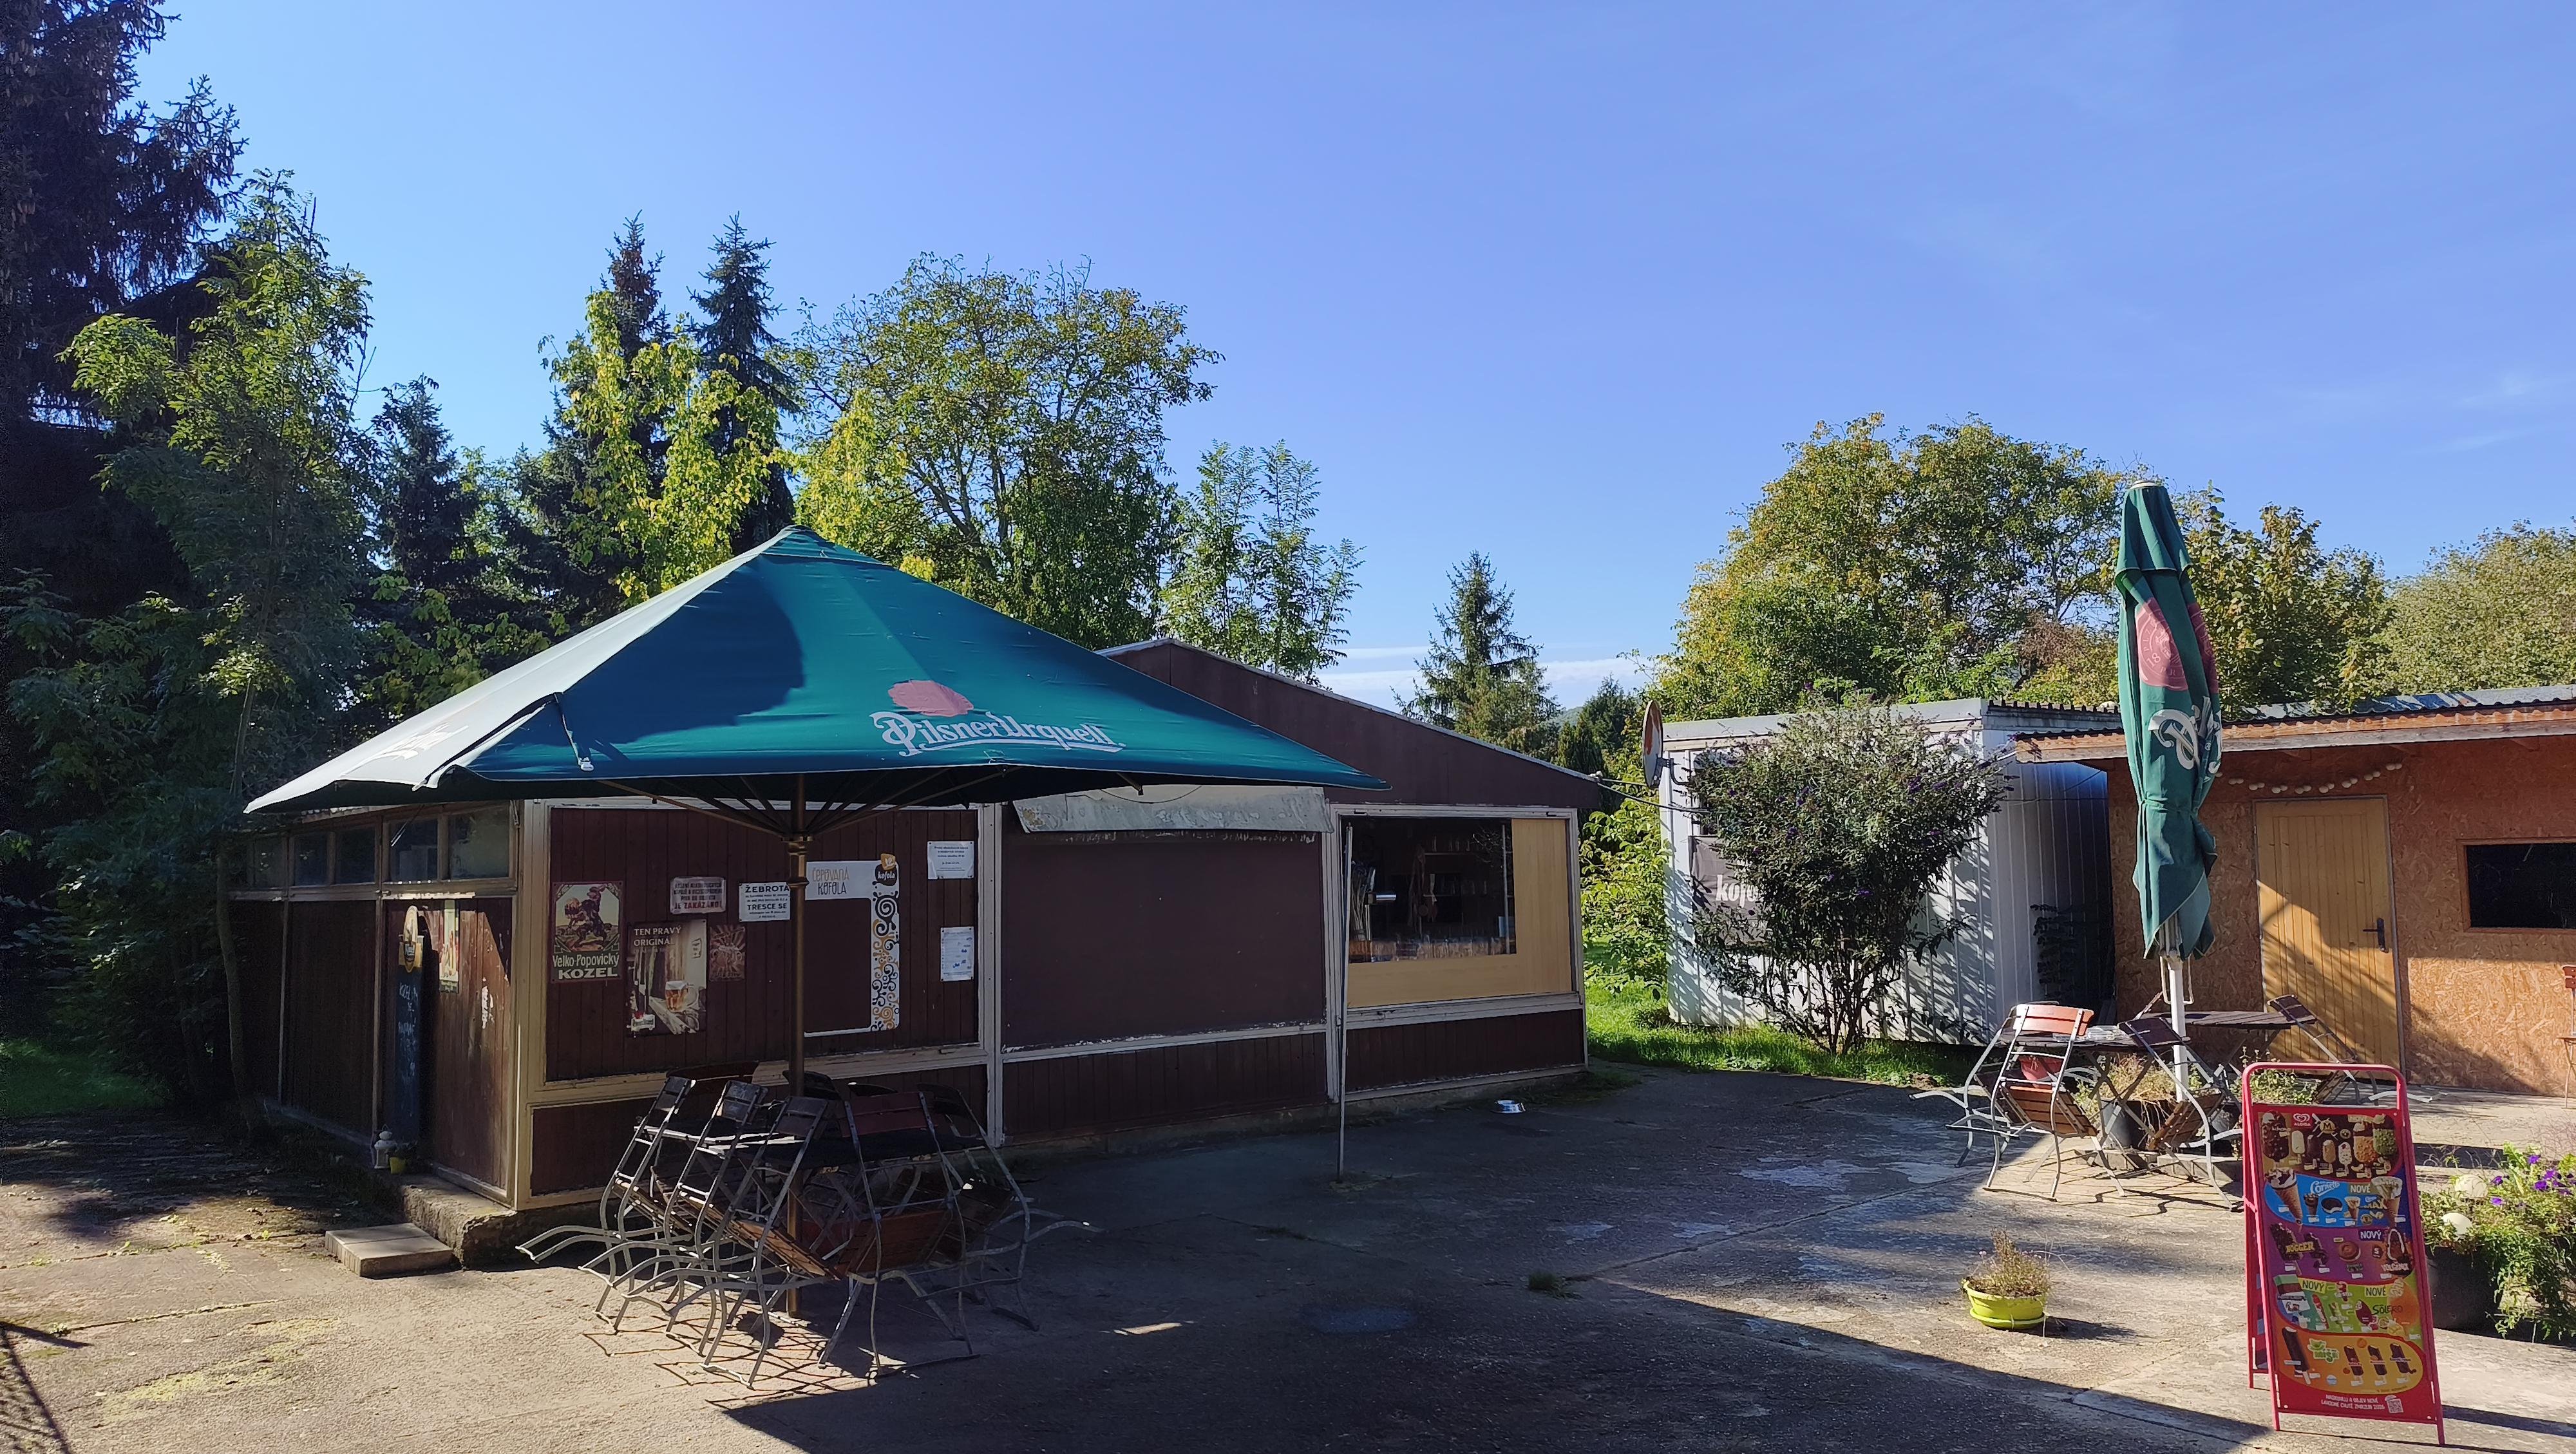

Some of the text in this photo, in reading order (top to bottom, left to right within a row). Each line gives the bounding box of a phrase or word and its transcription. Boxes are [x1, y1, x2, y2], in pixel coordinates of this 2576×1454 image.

[869, 710, 1119, 757] Pilsner Urquell
[878, 871, 895, 881] kofola
[745, 884, 790, 893] ŽEBROTA
[818, 882, 847, 896] KOFOLA
[653, 925, 681, 934] PRAVÝ
[553, 952, 620, 968] Velko-Popovický
[558, 967, 618, 979] KOZEL
[2350, 1183, 2371, 1193] NOVÉ
[2360, 1231, 2382, 1240] NOVÝ
[2302, 1280, 2324, 1292] NOVÝ
[2365, 1287, 2386, 1296] NOVÉ
